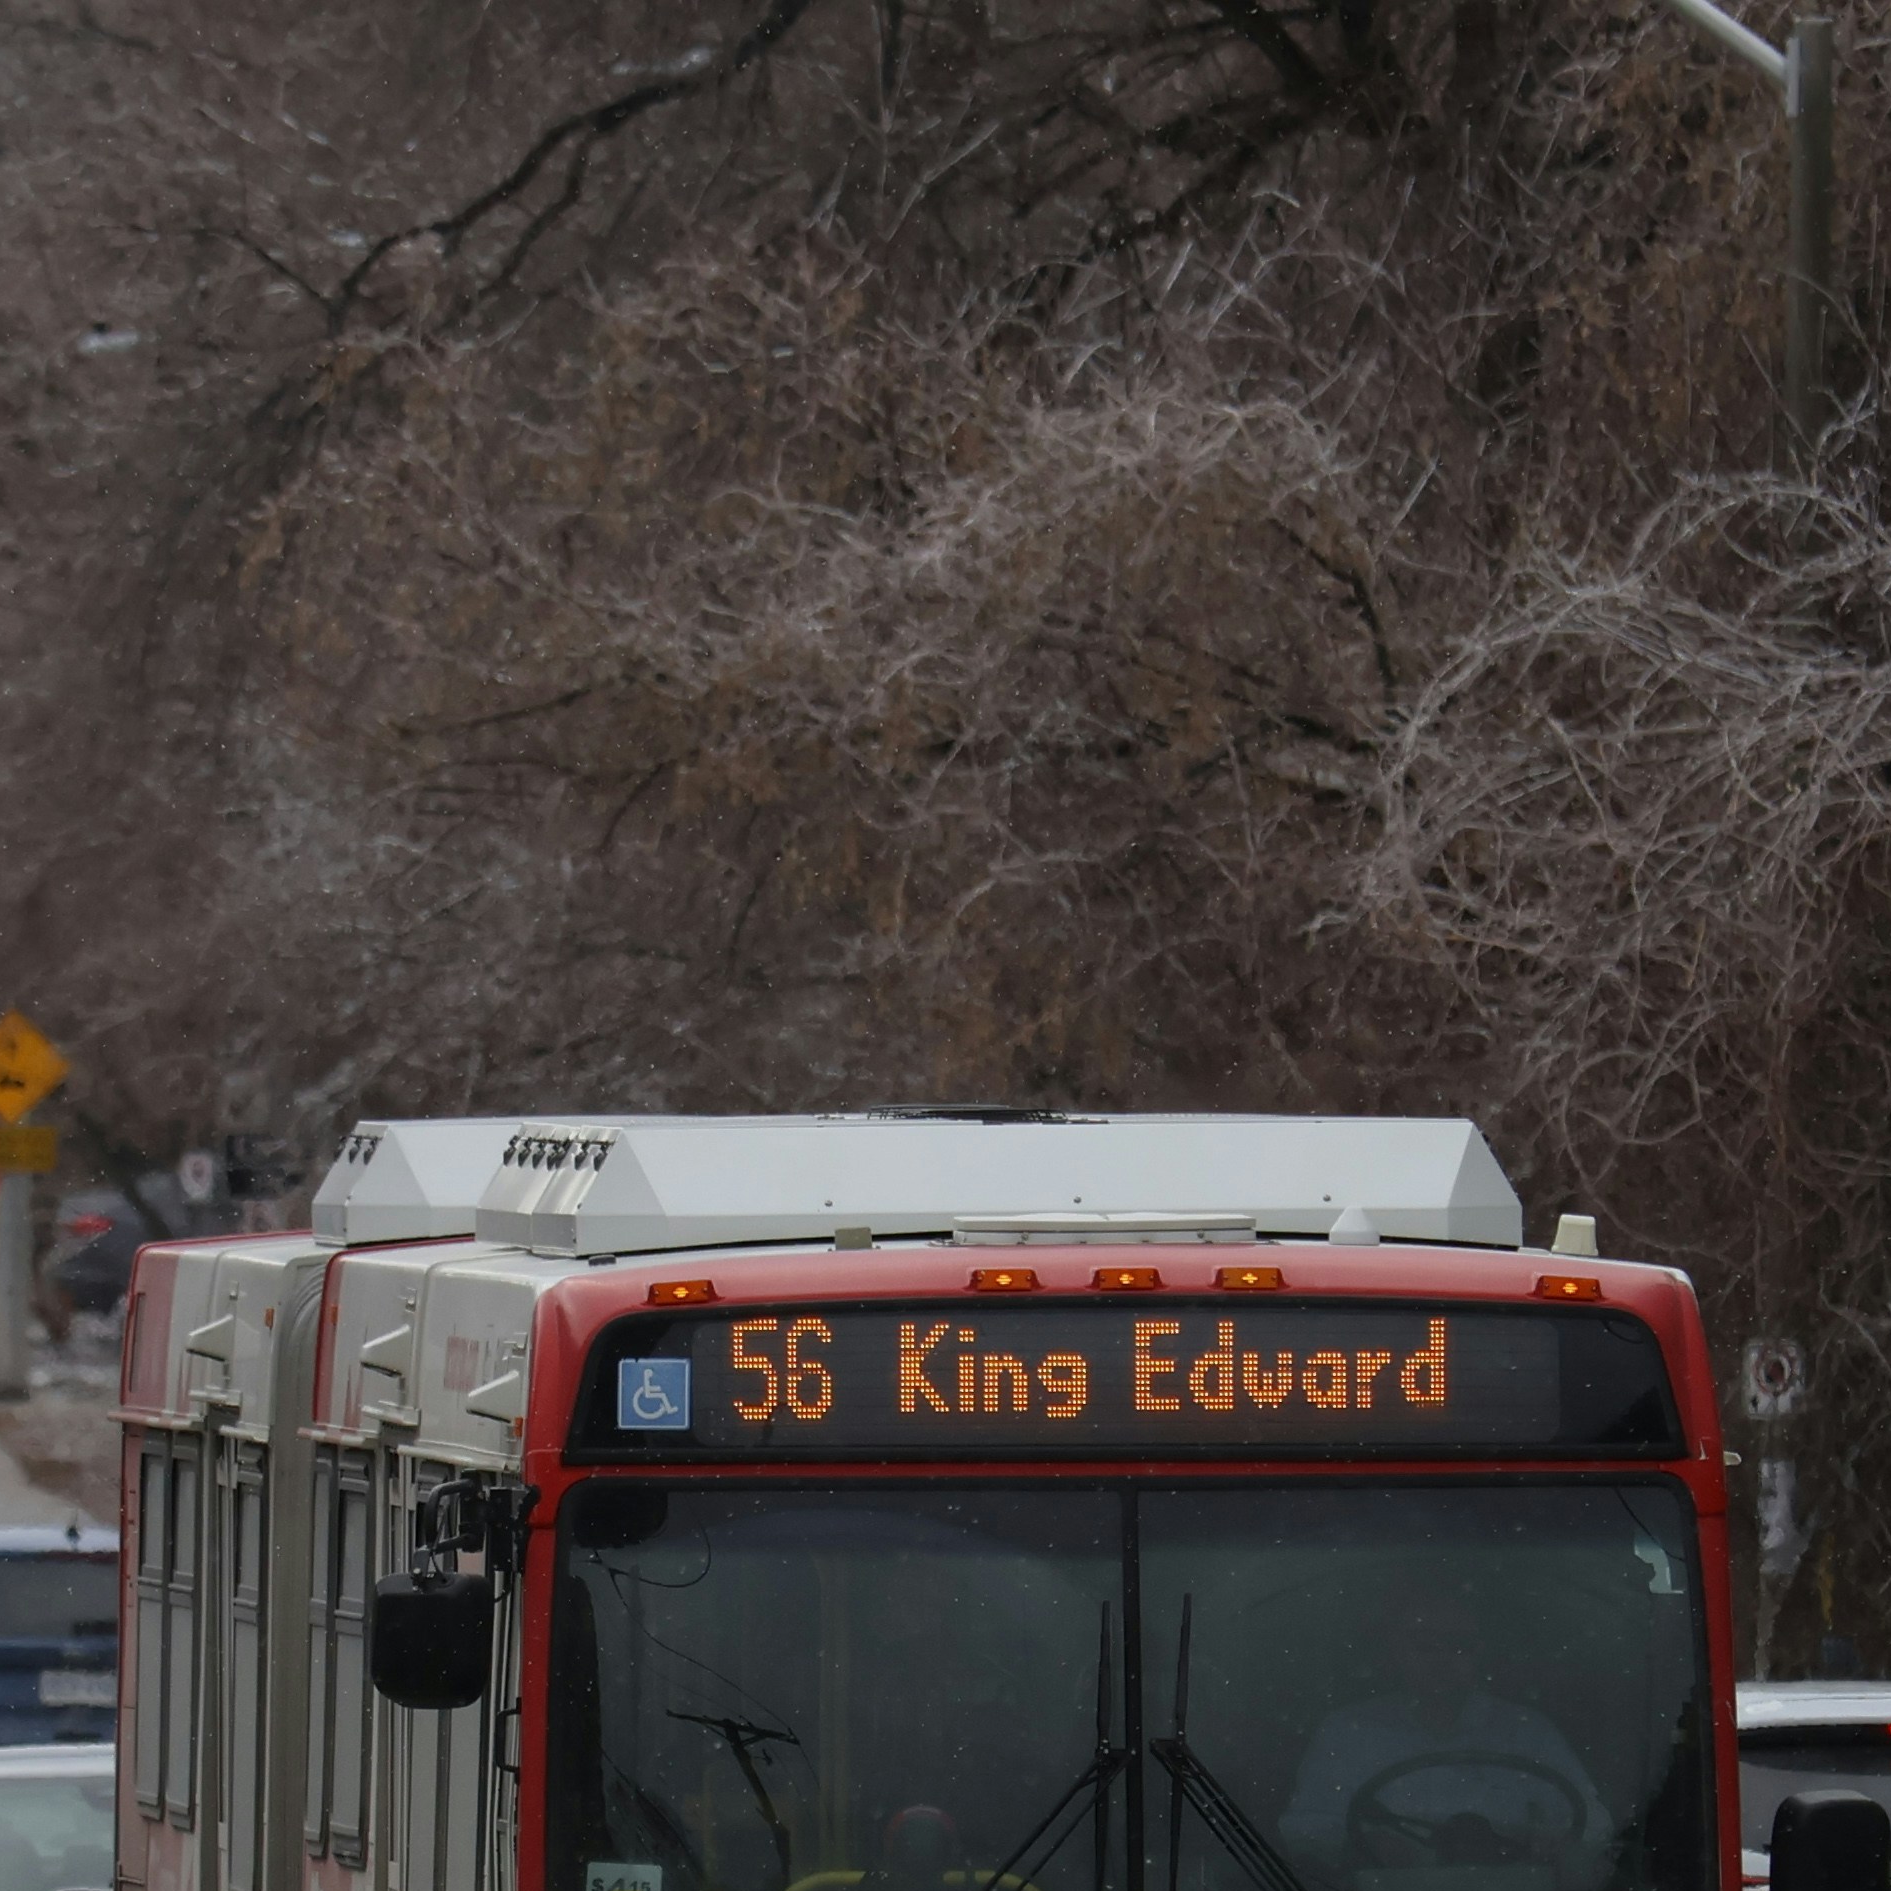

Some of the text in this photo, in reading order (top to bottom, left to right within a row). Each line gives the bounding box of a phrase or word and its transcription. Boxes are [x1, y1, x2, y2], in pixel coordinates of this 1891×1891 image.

[729, 1316, 1448, 1421] 56 King Edward
